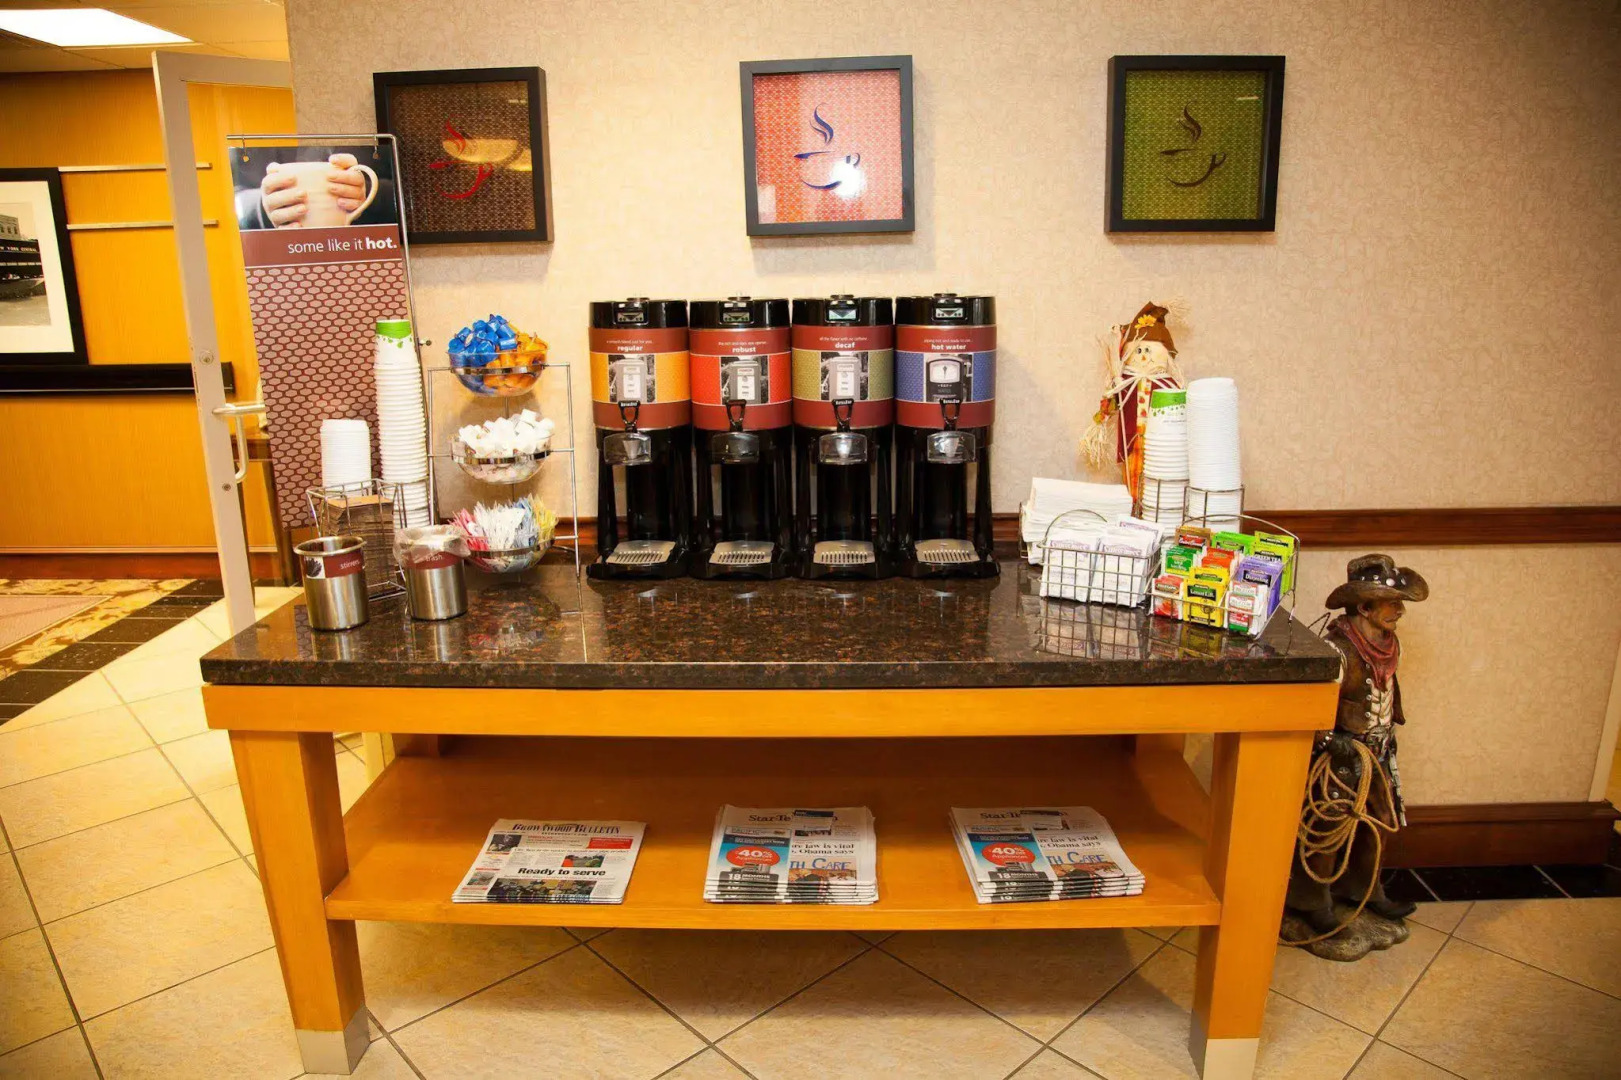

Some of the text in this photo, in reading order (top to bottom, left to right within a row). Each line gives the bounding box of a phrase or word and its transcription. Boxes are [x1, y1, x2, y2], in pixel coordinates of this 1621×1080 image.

[287, 236, 397, 254] some like it hot.
[574, 824, 621, 834] BULLETIN
[1067, 851, 1105, 864] CARE
[812, 858, 852, 871] CARE
[517, 868, 555, 876] Ready
